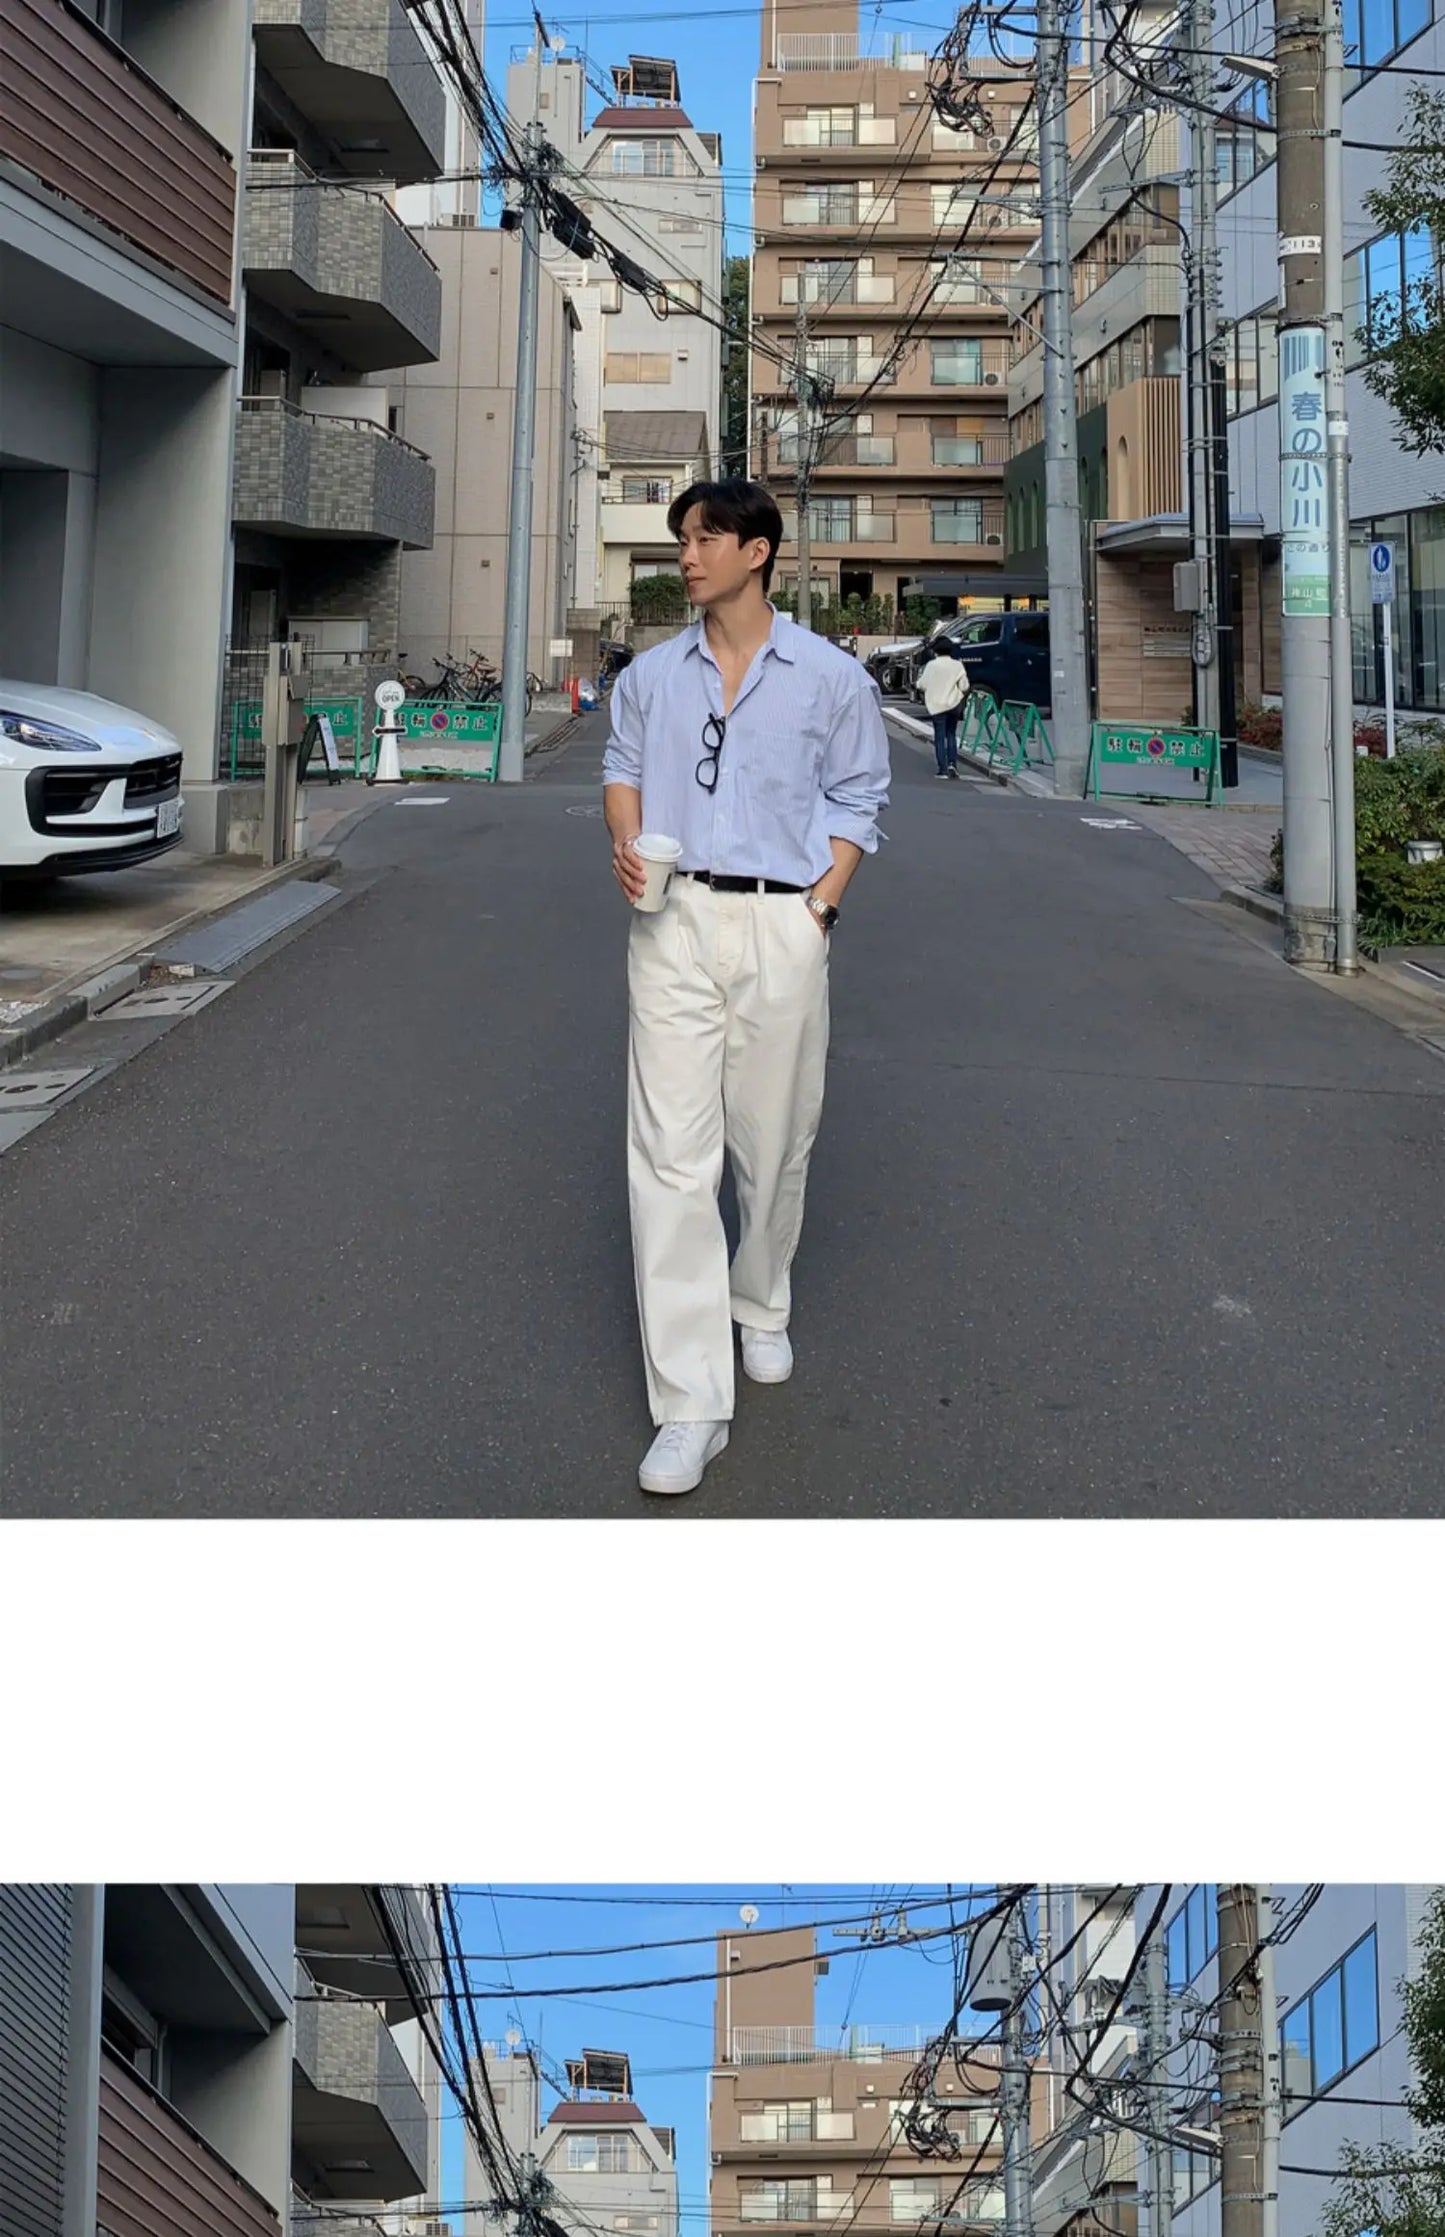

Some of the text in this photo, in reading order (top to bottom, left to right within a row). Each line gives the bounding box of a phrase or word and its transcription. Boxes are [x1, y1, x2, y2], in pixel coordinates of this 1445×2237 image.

[1291, 391, 1323, 527] 春の小川
[453, 714, 488, 731] 禁止
[1106, 736, 1205, 757] 駐輪 禁止
